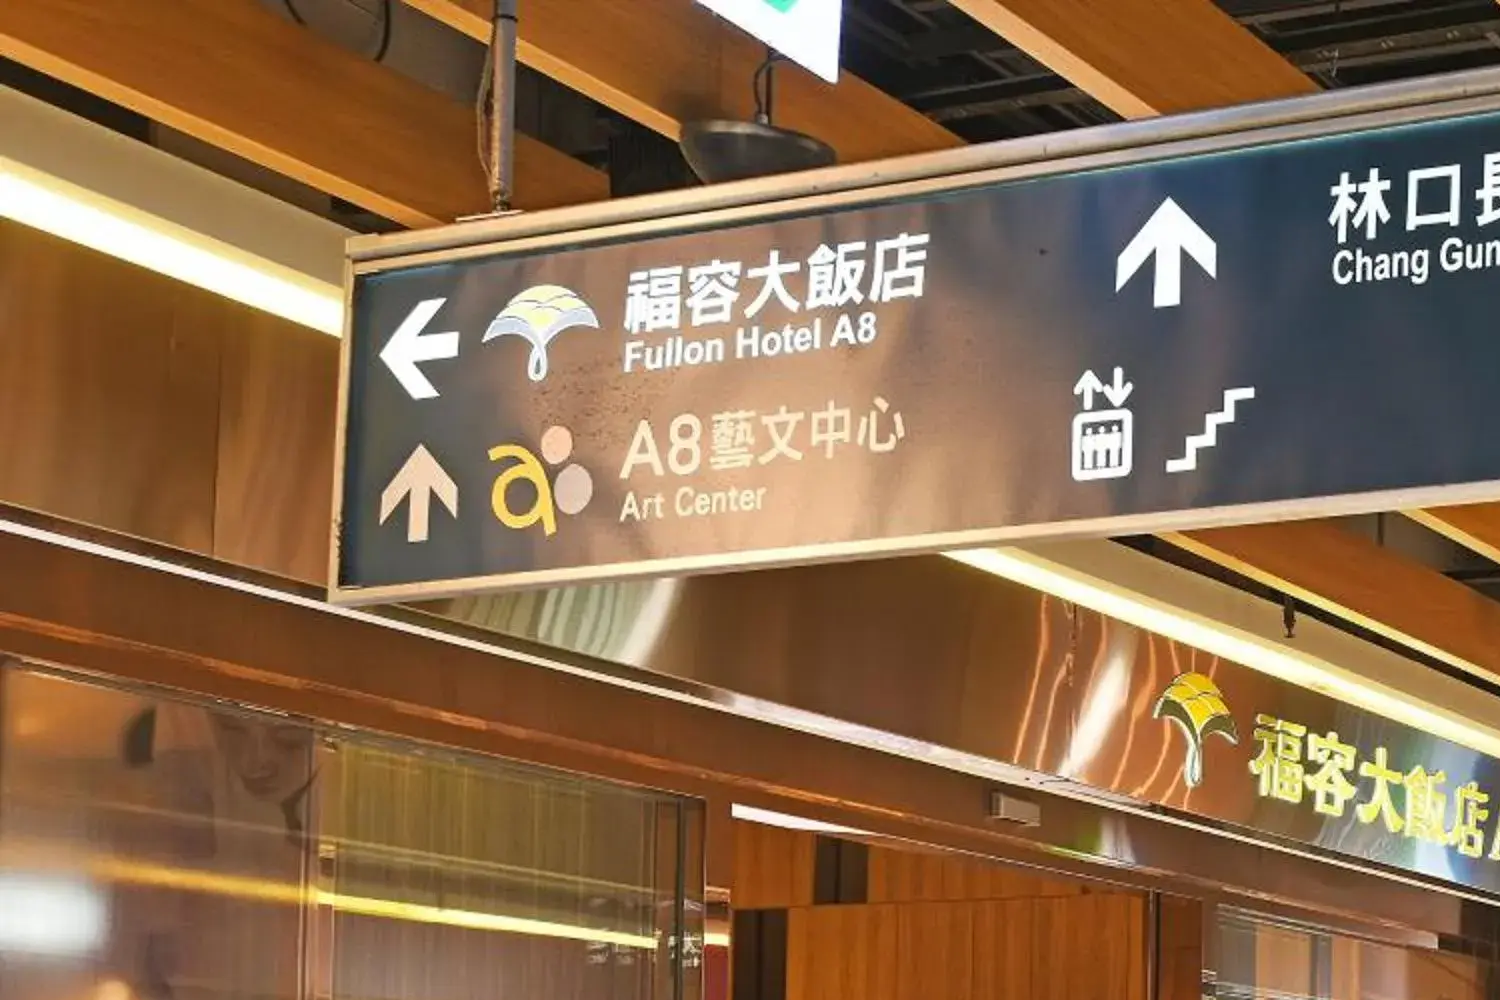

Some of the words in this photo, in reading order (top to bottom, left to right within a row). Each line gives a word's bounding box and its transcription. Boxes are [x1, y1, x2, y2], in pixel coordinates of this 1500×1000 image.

[623, 232, 930, 334] 福容大飯店
[1332, 242, 1430, 285] Chang
[623, 336, 724, 373] Fullon
[735, 317, 821, 359] Hotel
[830, 311, 877, 347] A8
[619, 491, 665, 522] Art
[674, 485, 767, 517] Center
